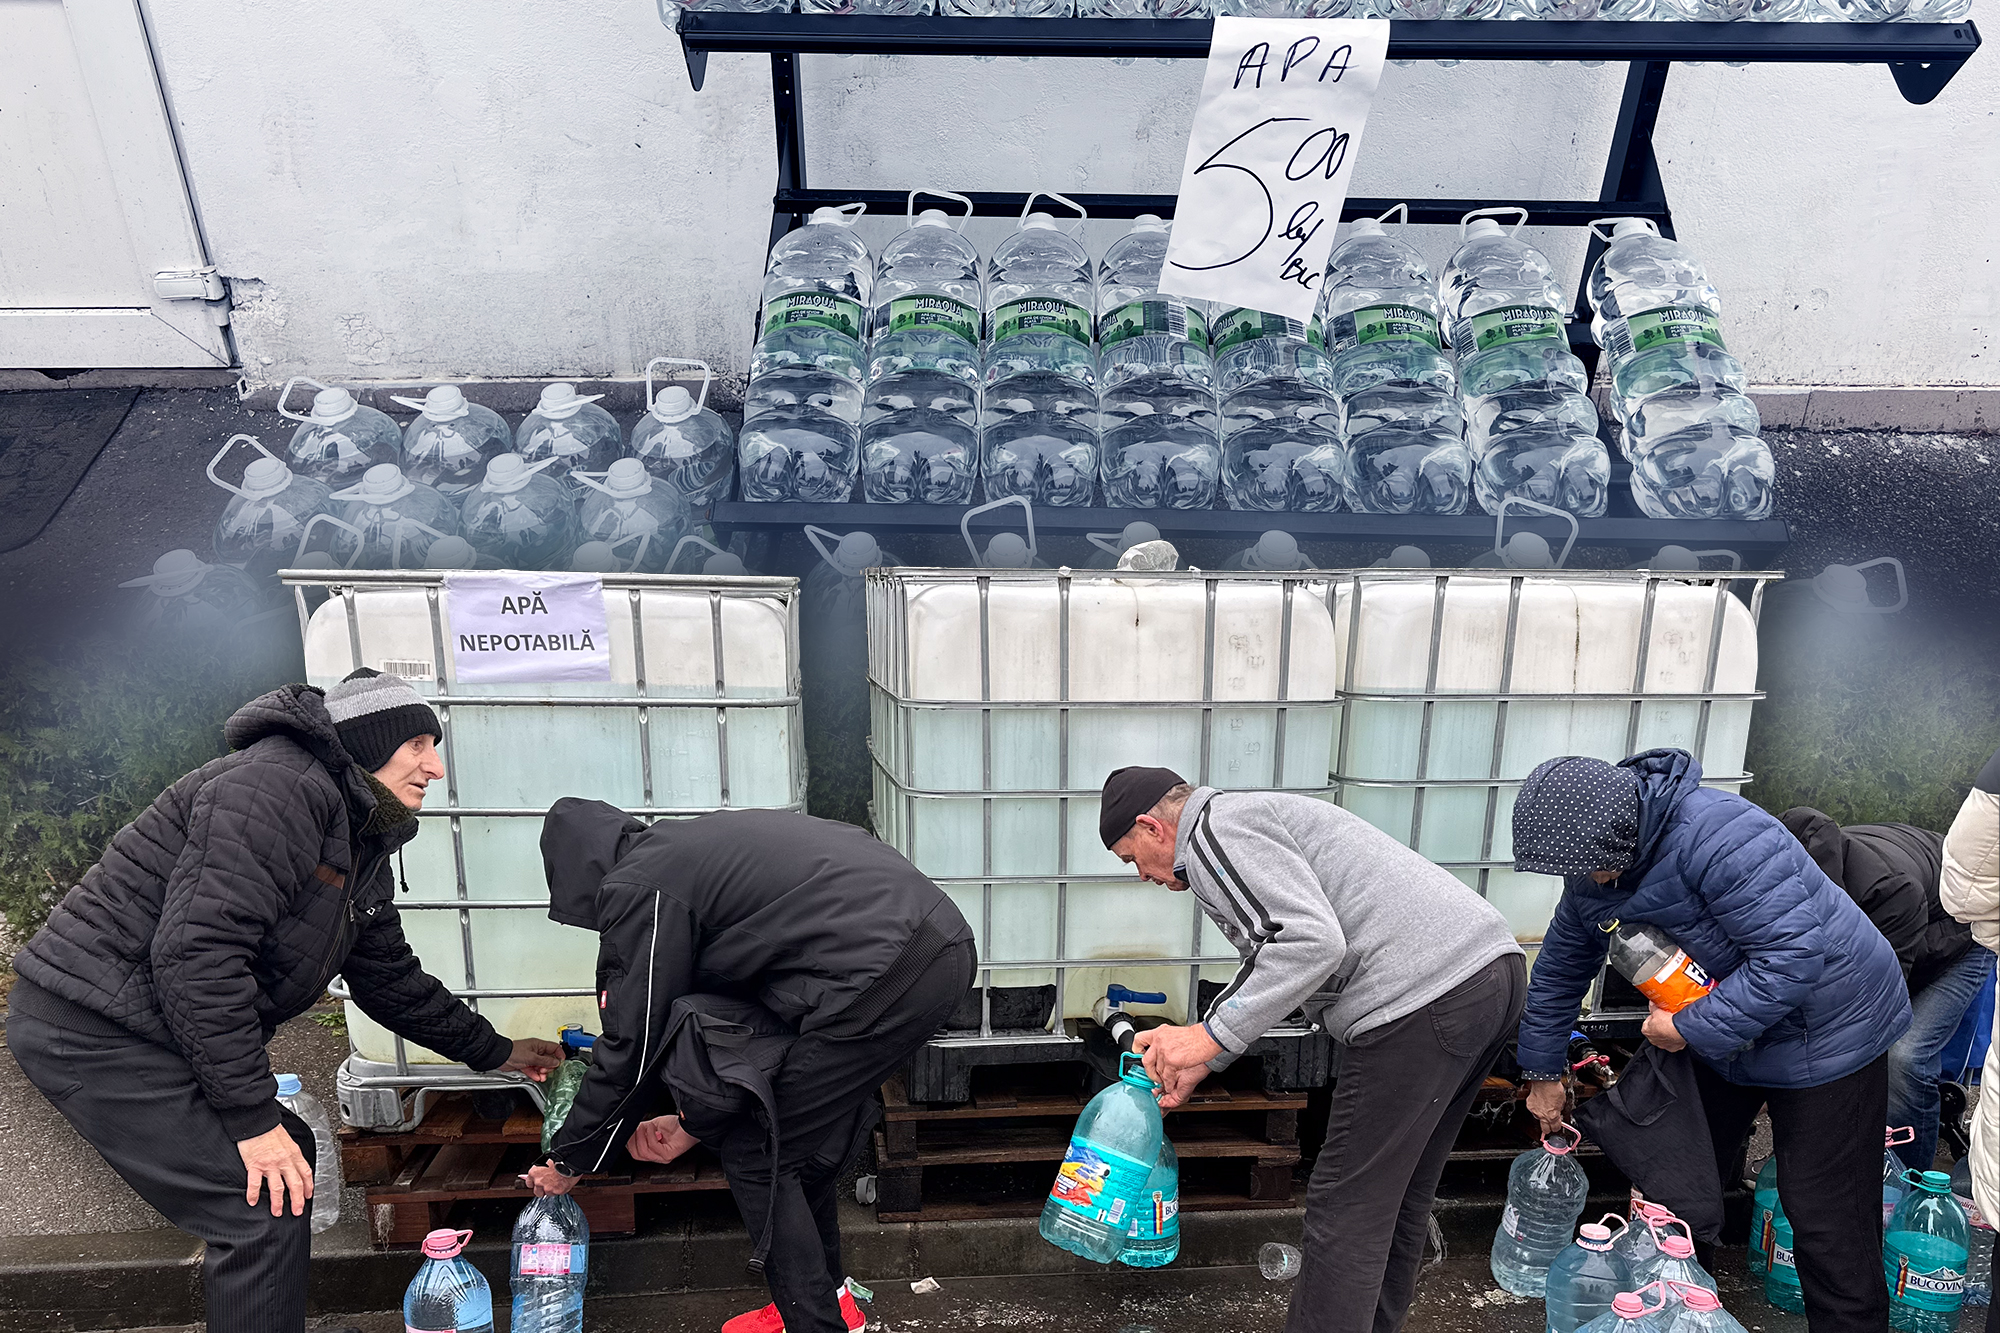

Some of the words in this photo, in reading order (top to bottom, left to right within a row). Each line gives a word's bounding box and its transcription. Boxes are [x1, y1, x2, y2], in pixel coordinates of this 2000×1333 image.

[1233, 36, 1360, 90] APA
[786, 295, 836, 310] MIRAQUA
[915, 297, 963, 317] MIRAQUA
[1018, 300, 1067, 316] MIRAQUA
[1382, 307, 1430, 327] MIRAQUA
[1500, 308, 1555, 322] MIRAQUA
[1659, 309, 1710, 325] MIRAQUA
[500, 591, 549, 615] APĂ
[459, 629, 595, 652] NEPOTABILĂ
[1910, 1275, 1963, 1291] BUCOVIN
